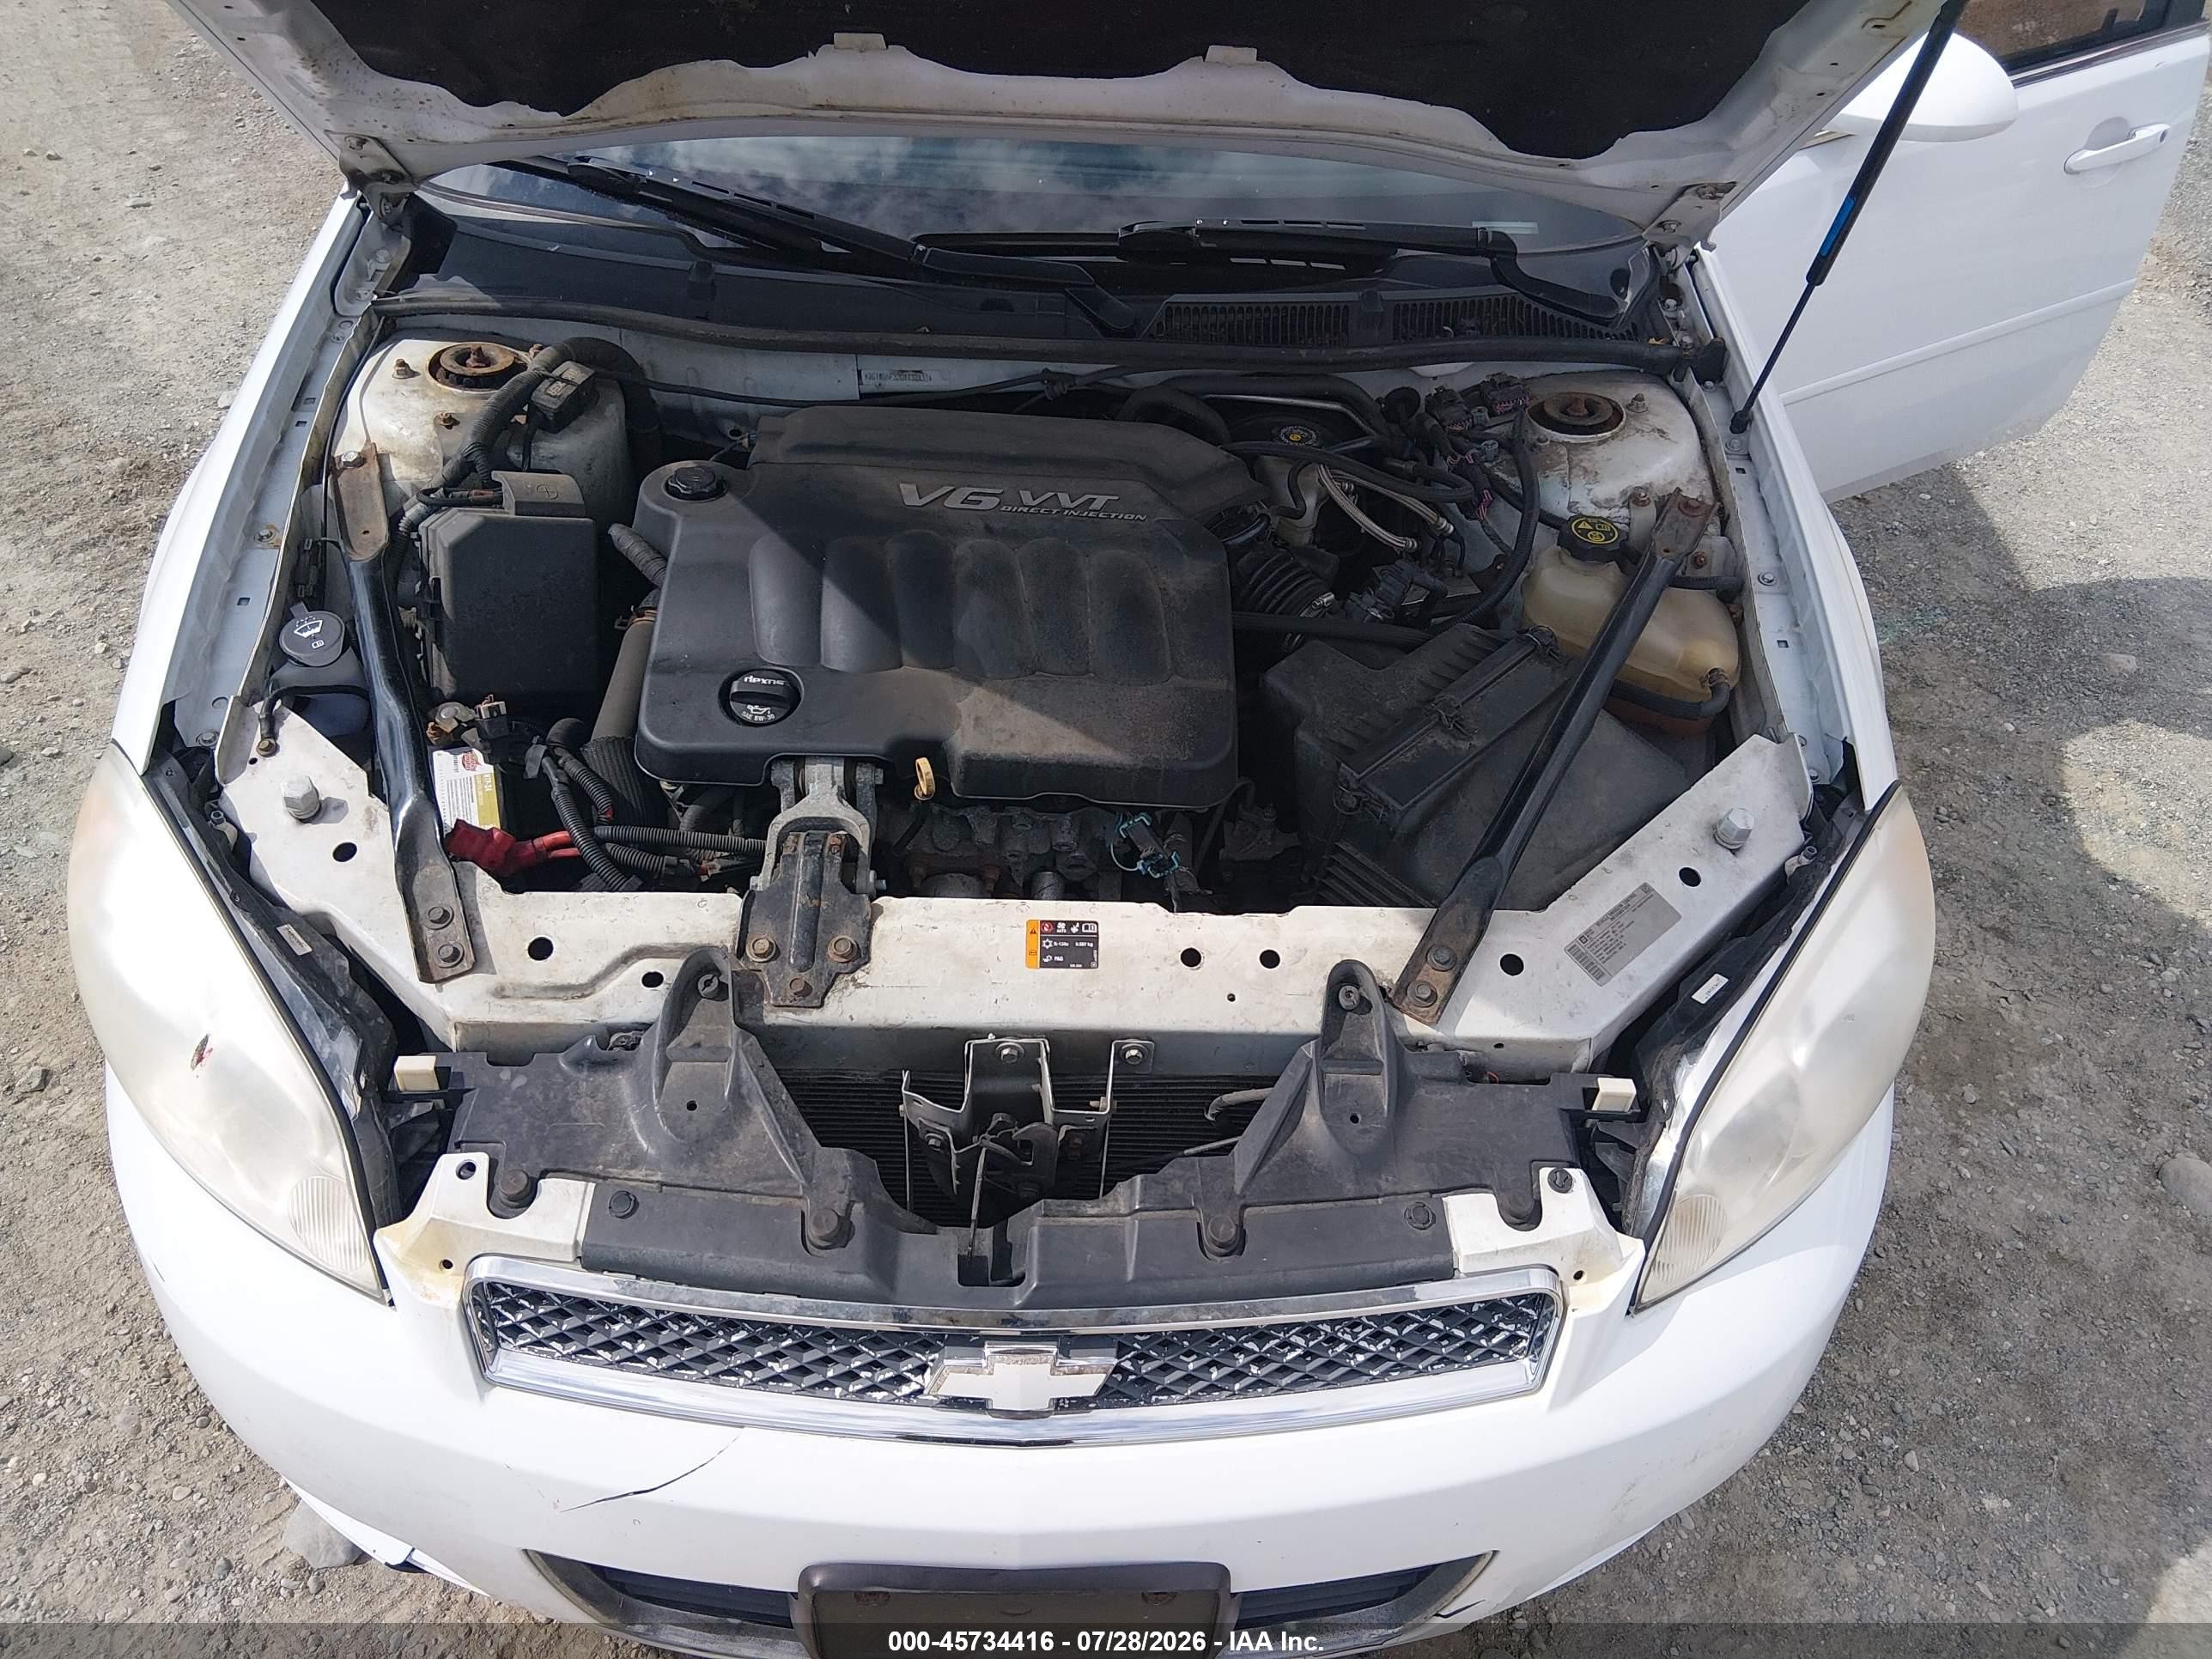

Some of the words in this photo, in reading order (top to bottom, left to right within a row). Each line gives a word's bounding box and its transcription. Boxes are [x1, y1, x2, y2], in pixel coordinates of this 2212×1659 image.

[899, 483, 1004, 510] V6
[1018, 490, 1119, 511] VVT
[1000, 505, 1060, 515] DIRECT
[1063, 509, 1147, 521] INJECTION
[741, 710, 753, 720] SAE
